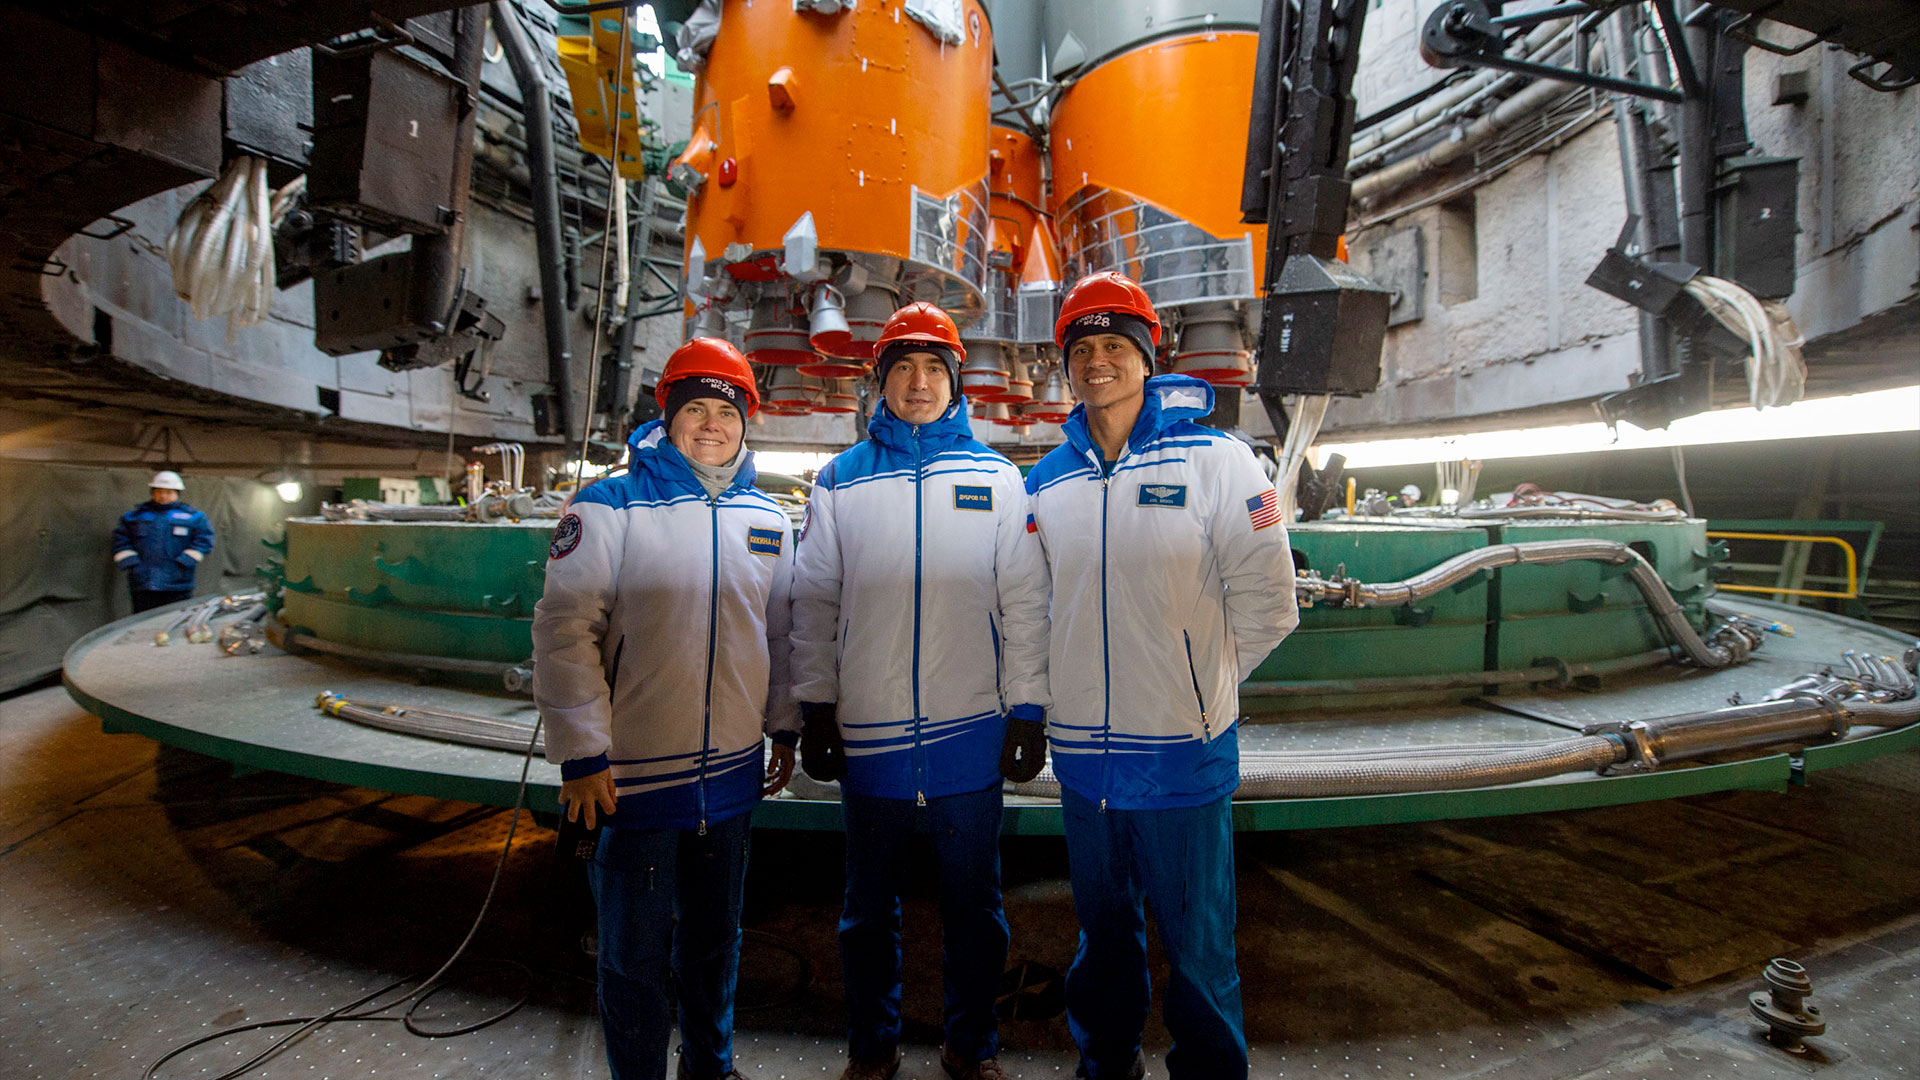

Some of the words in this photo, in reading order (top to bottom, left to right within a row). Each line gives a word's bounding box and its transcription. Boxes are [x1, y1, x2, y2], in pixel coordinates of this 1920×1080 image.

[1145, 16, 1153, 29] 2
[409, 119, 418, 137] 1
[1094, 315, 1110, 327] 28
[721, 383, 736, 399] 28
